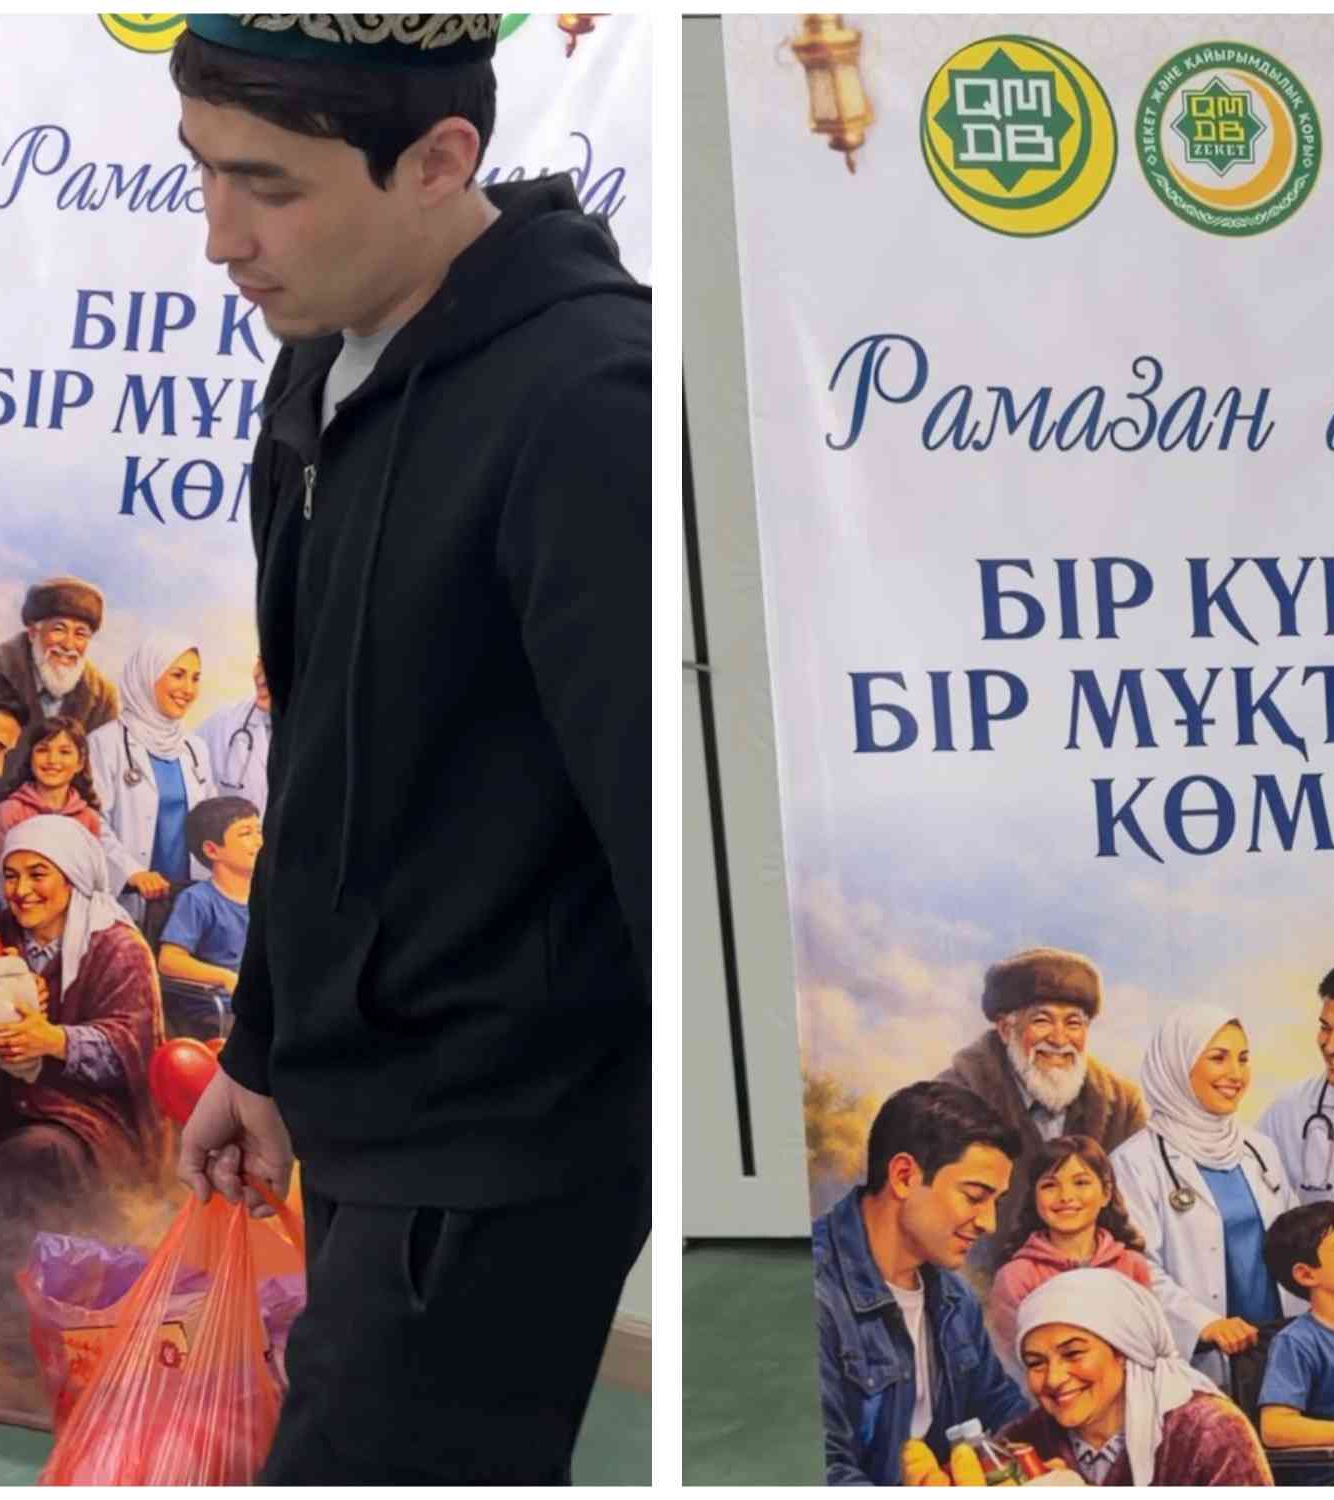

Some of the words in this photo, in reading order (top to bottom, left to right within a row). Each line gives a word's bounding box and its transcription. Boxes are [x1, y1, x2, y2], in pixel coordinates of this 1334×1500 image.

[1194, 144, 1246, 157] ZEKET
[70, 288, 196, 353] БІР
[826, 332, 1275, 453] Рамазан
[976, 555, 1155, 641] БІР
[848, 667, 1031, 755] БІР
